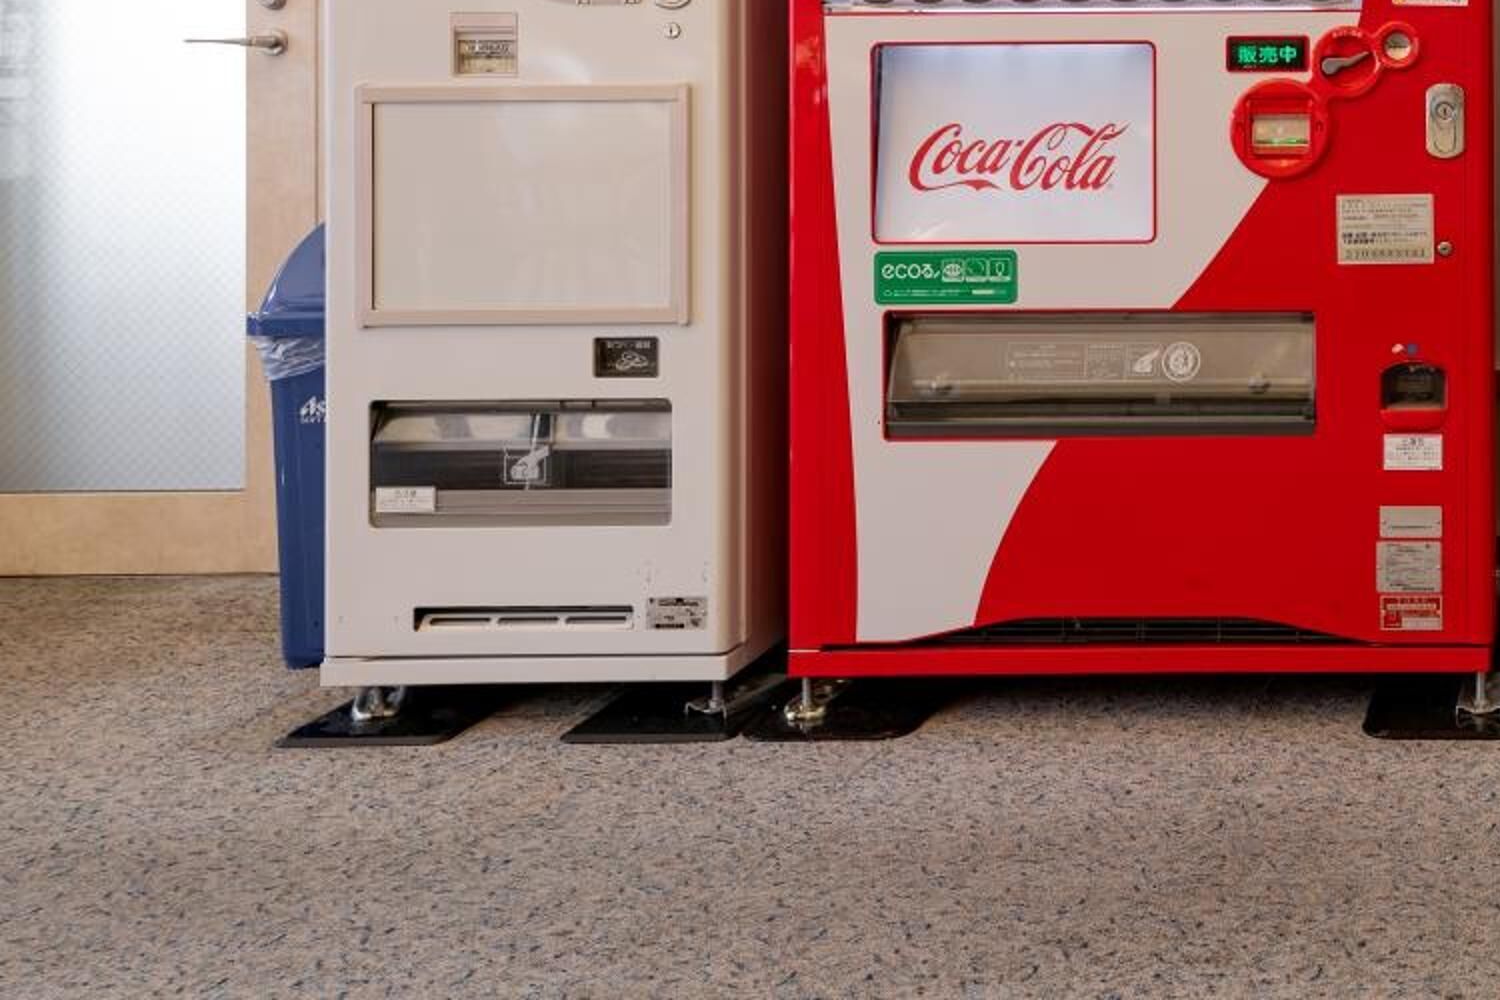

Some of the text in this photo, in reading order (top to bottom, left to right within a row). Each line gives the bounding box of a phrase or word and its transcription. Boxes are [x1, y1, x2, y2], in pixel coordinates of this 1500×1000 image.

[1238, 45, 1297, 64] 販売中
[908, 121, 1131, 191] Coca-Cola
